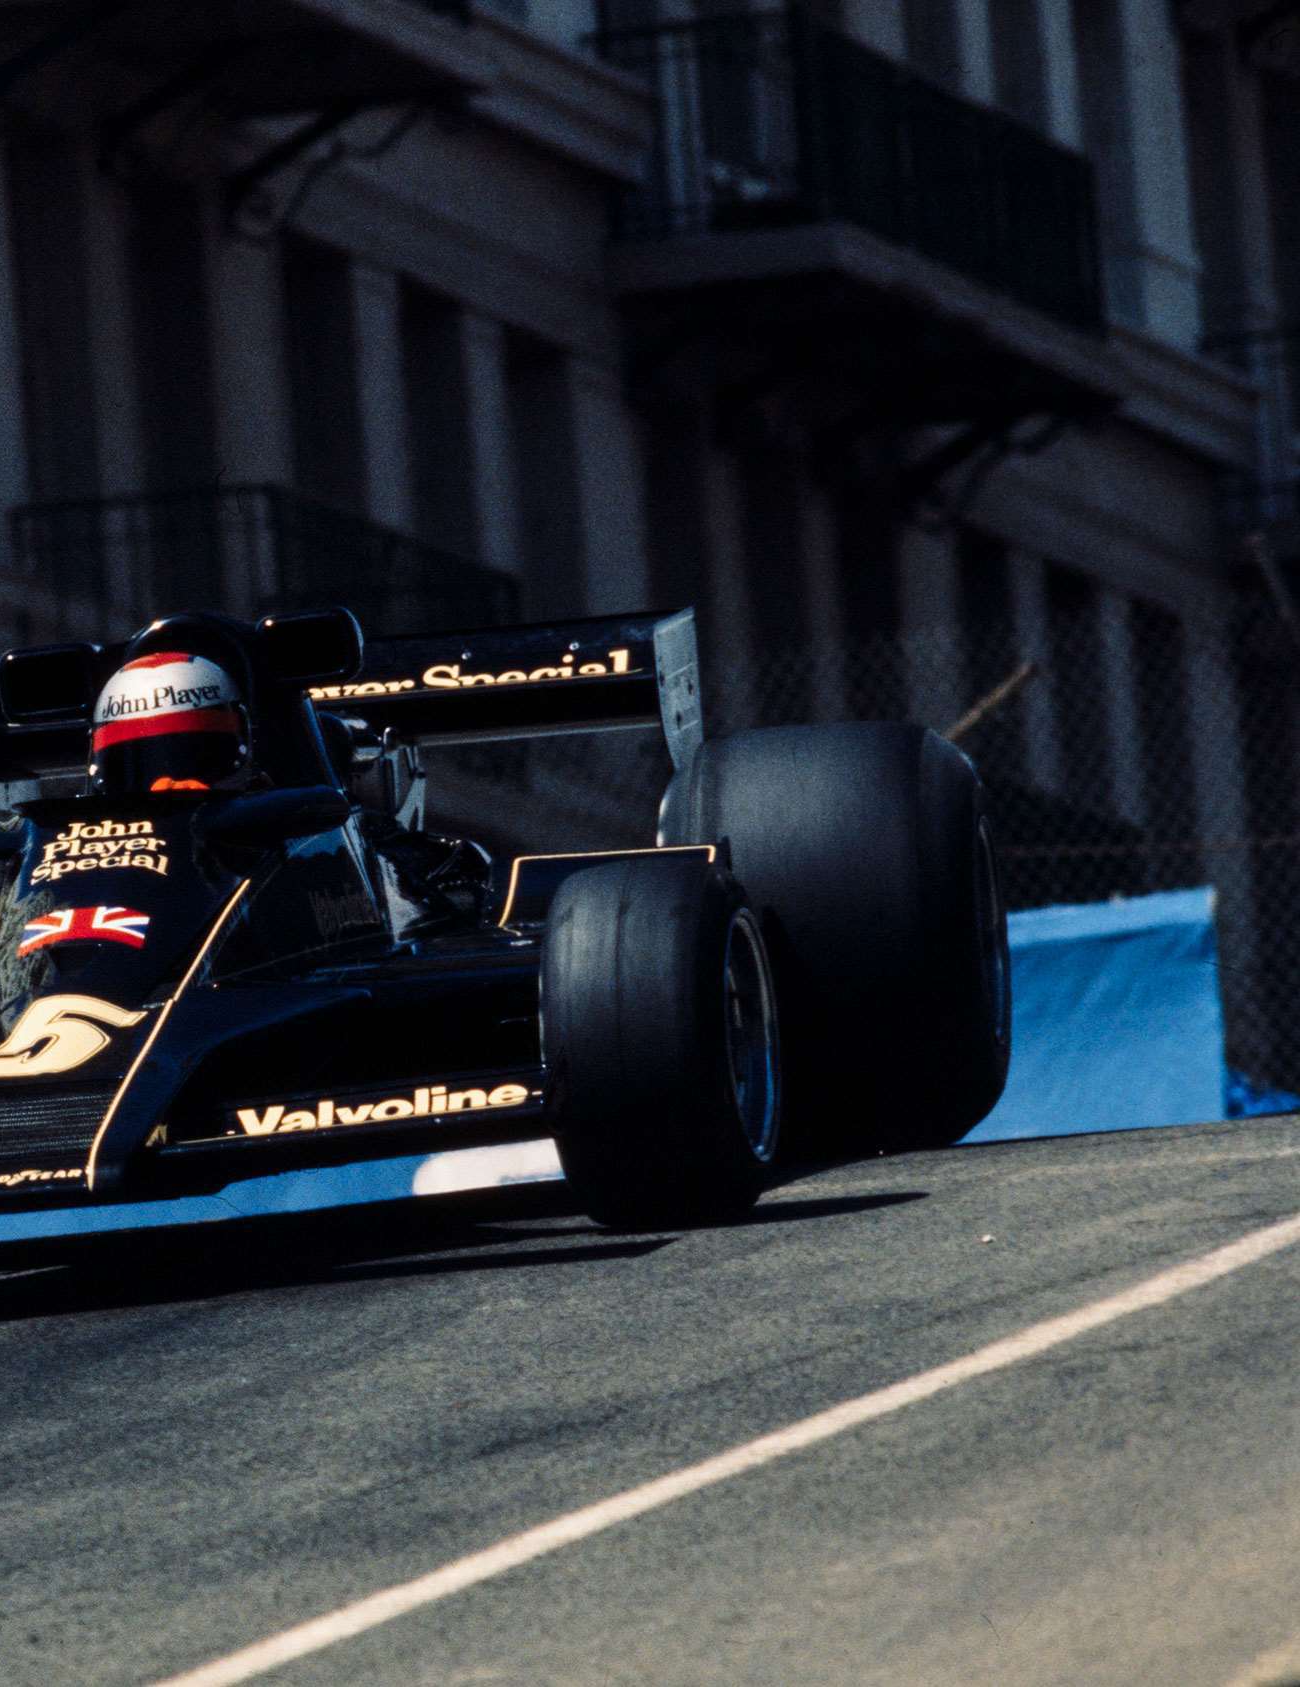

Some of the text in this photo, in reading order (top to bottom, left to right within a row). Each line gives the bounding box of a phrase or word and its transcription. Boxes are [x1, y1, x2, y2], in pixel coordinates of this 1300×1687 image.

[102, 685, 221, 719] John Player
[56, 820, 153, 840] John
[42, 837, 166, 862] Player
[30, 851, 168, 886] Special
[237, 1083, 530, 1135] Valvoline
